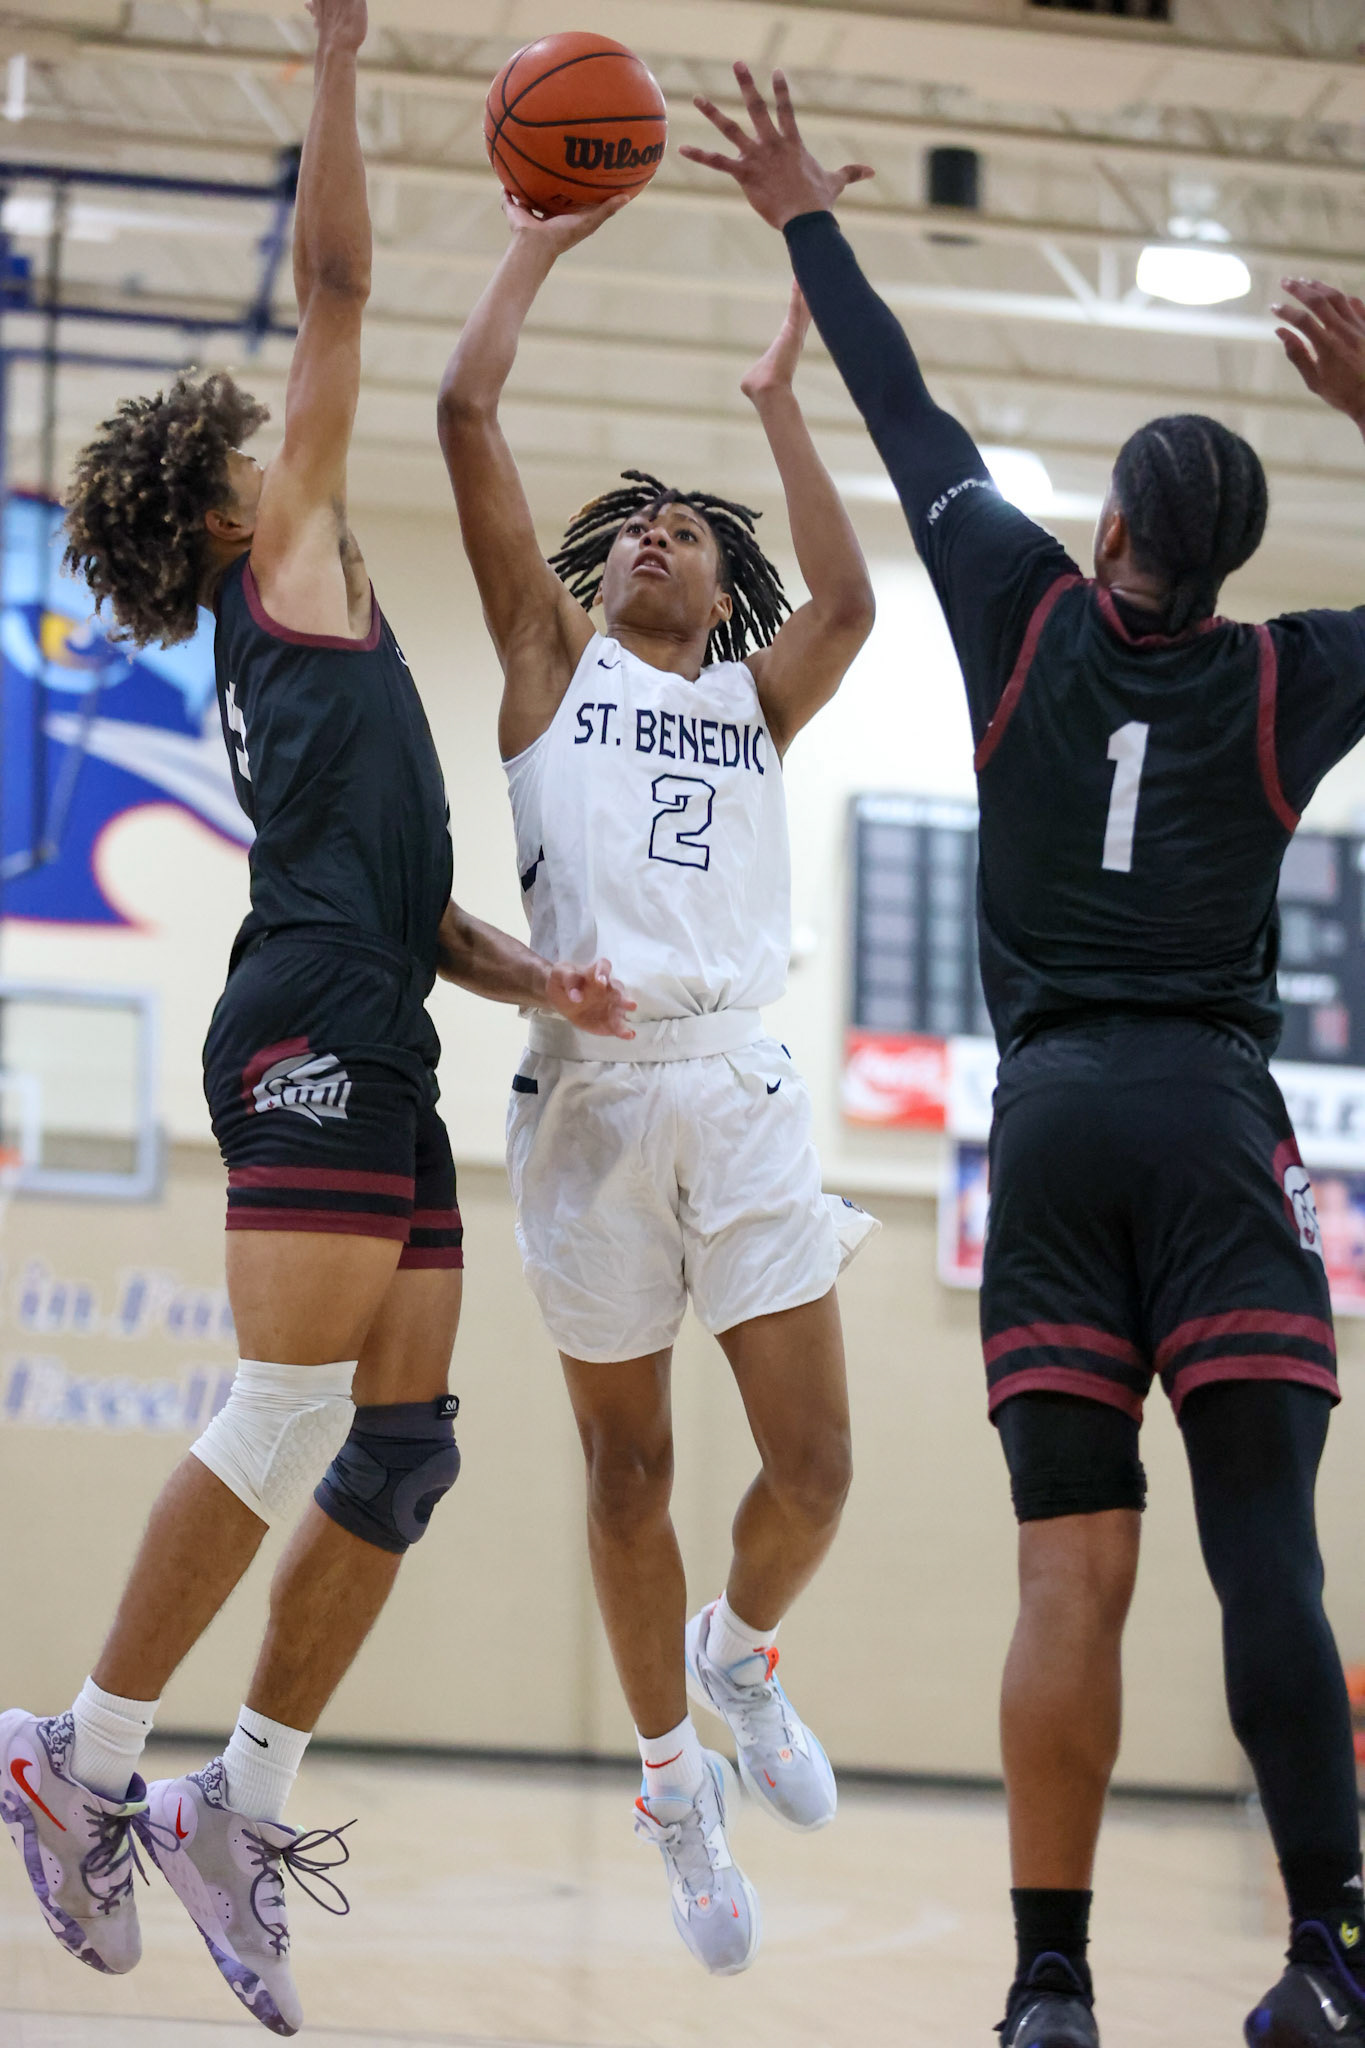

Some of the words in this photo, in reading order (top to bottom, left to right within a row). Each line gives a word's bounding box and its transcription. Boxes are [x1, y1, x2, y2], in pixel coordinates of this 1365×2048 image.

[564, 135, 664, 170] Wilson
[574, 702, 621, 745] ST.
[649, 773, 716, 871] 2
[1102, 720, 1149, 872] 1
